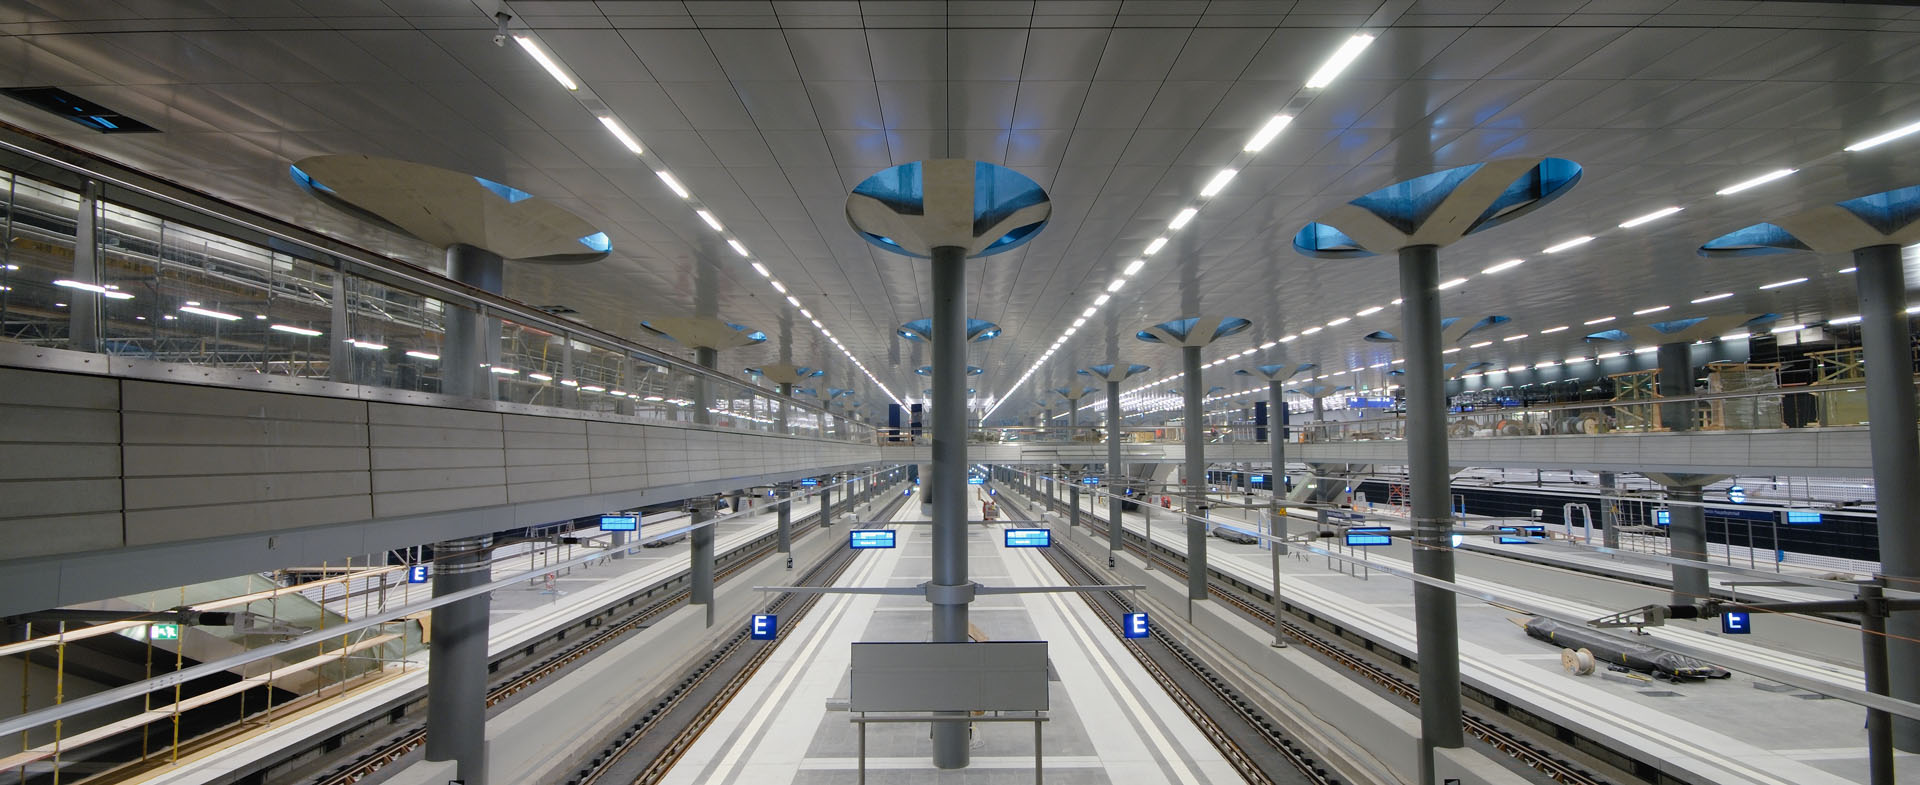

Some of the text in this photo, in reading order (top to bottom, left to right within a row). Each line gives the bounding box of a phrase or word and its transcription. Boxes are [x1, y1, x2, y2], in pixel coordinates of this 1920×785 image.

[414, 566, 424, 581] E
[754, 615, 767, 635] E
[1133, 613, 1146, 633] E
